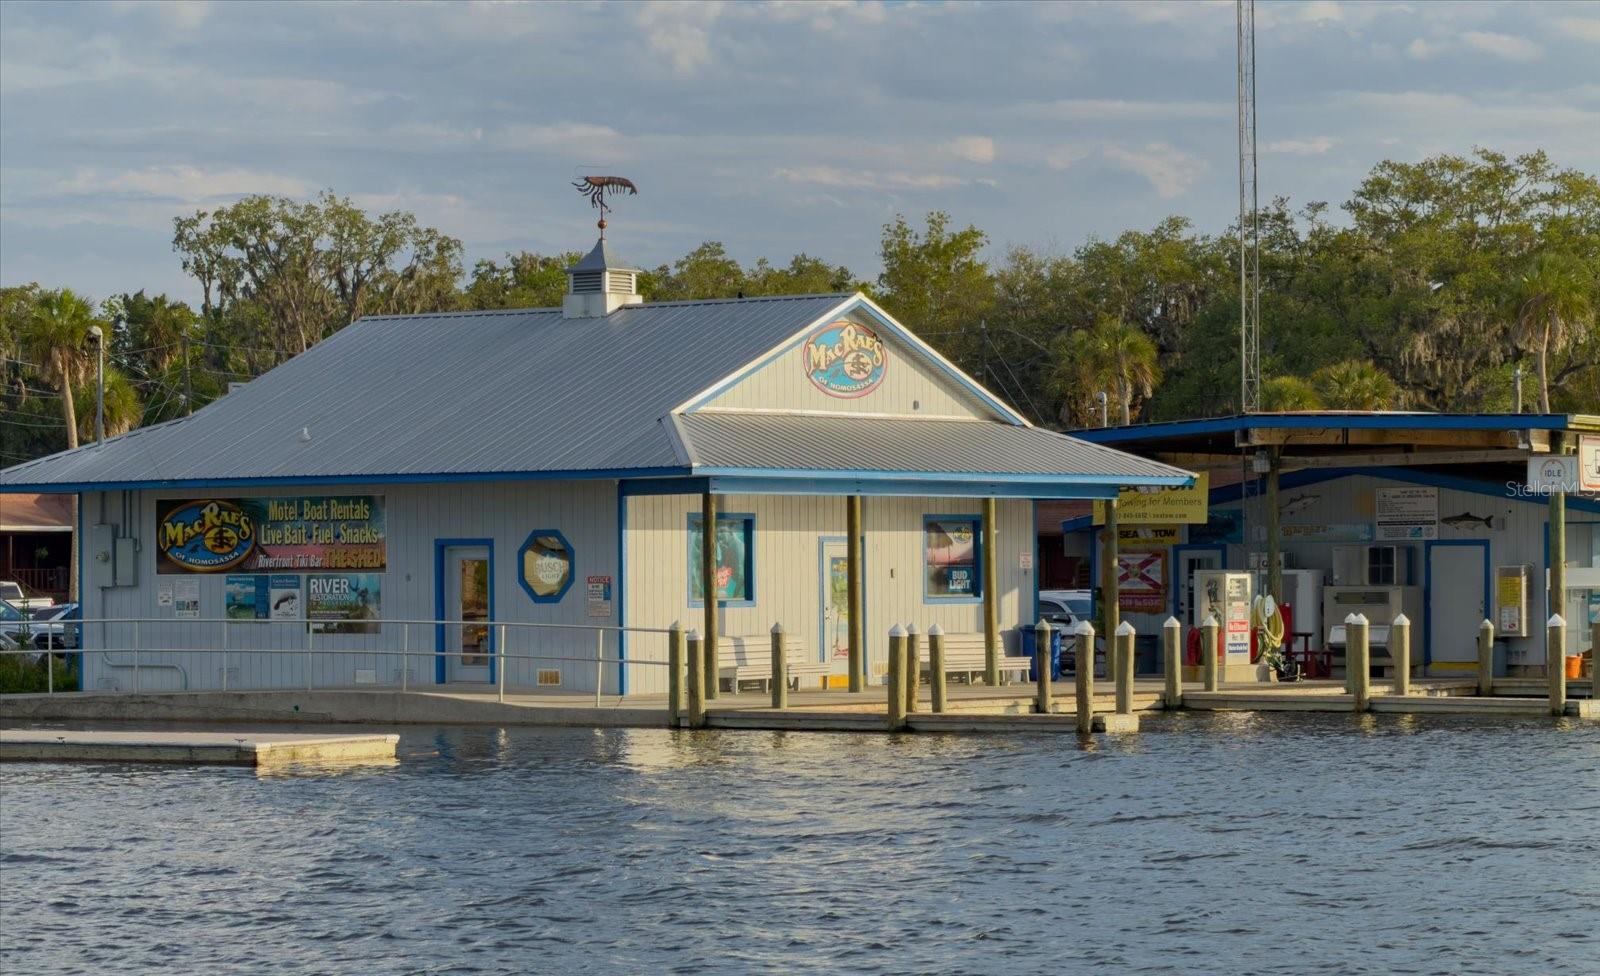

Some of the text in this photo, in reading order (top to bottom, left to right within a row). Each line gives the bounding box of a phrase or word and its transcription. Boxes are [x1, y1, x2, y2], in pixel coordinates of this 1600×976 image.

[1544, 469, 1562, 477] IDLE
[1149, 496, 1161, 506] for
[1162, 496, 1202, 506] Members
[268, 498, 370, 520] Motel Boat Rentals
[261, 522, 379, 545] Live Bait Fuel Snacks
[1119, 529, 1176, 539] SEA TOW
[189, 551, 240, 565] HOMOSASSA
[258, 554, 294, 568] Riverfront
[296, 554, 309, 568] Tiki
[310, 554, 323, 568] Bar
[951, 570, 968, 580] BUD
[310, 578, 349, 594] RIVER
[949, 579, 971, 589] LIGHT
